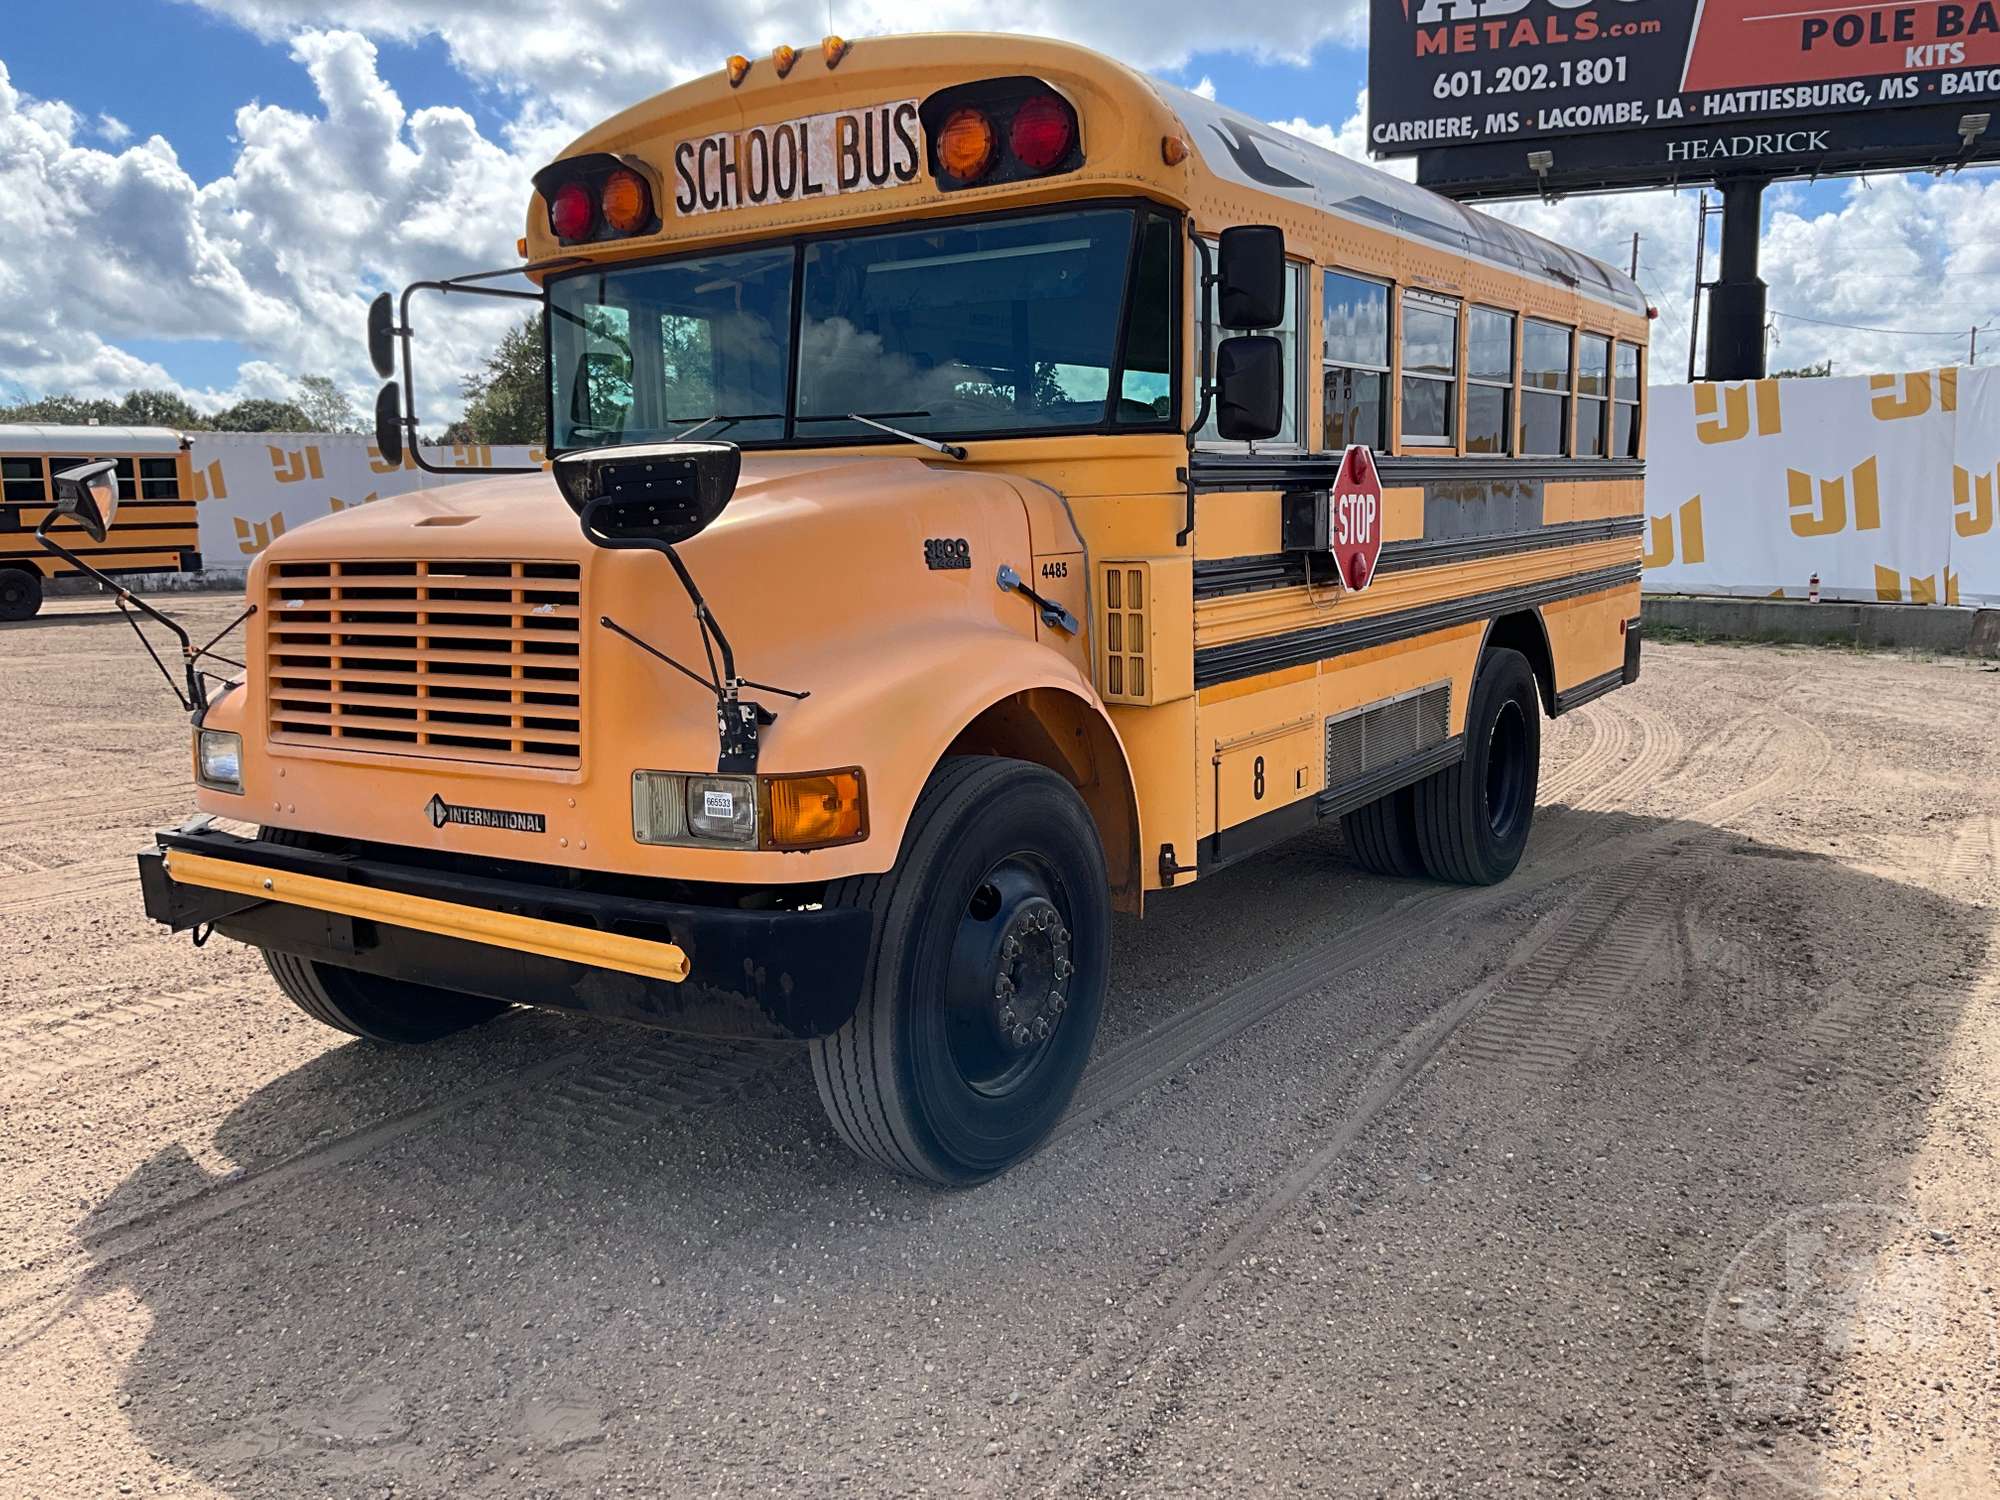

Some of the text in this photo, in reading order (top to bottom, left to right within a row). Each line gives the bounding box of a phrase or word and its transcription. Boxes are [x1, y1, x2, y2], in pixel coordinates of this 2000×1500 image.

[1802, 8, 1917, 51] POLE
[1905, 42, 1966, 68] KITS
[1433, 56, 1627, 99] 601.202.1801
[1372, 116, 1479, 144] CARRIERE,
[1485, 111, 1520, 134] MS
[1538, 101, 1650, 130] LACOMBE,
[1656, 97, 1684, 120] LA
[1703, 81, 1872, 116] HATTIESBURG,
[1879, 76, 1919, 100] MS
[675, 103, 919, 213] SCHOOL BUS
[1666, 130, 1830, 161] HEADRICK
[1338, 494, 1376, 545] STOP
[924, 538, 969, 559] 3800
[1041, 562, 1067, 579] 4485
[1254, 755, 1265, 800] 8
[449, 807, 542, 832] INTERNATIONAL
[706, 797, 731, 808] 665533
